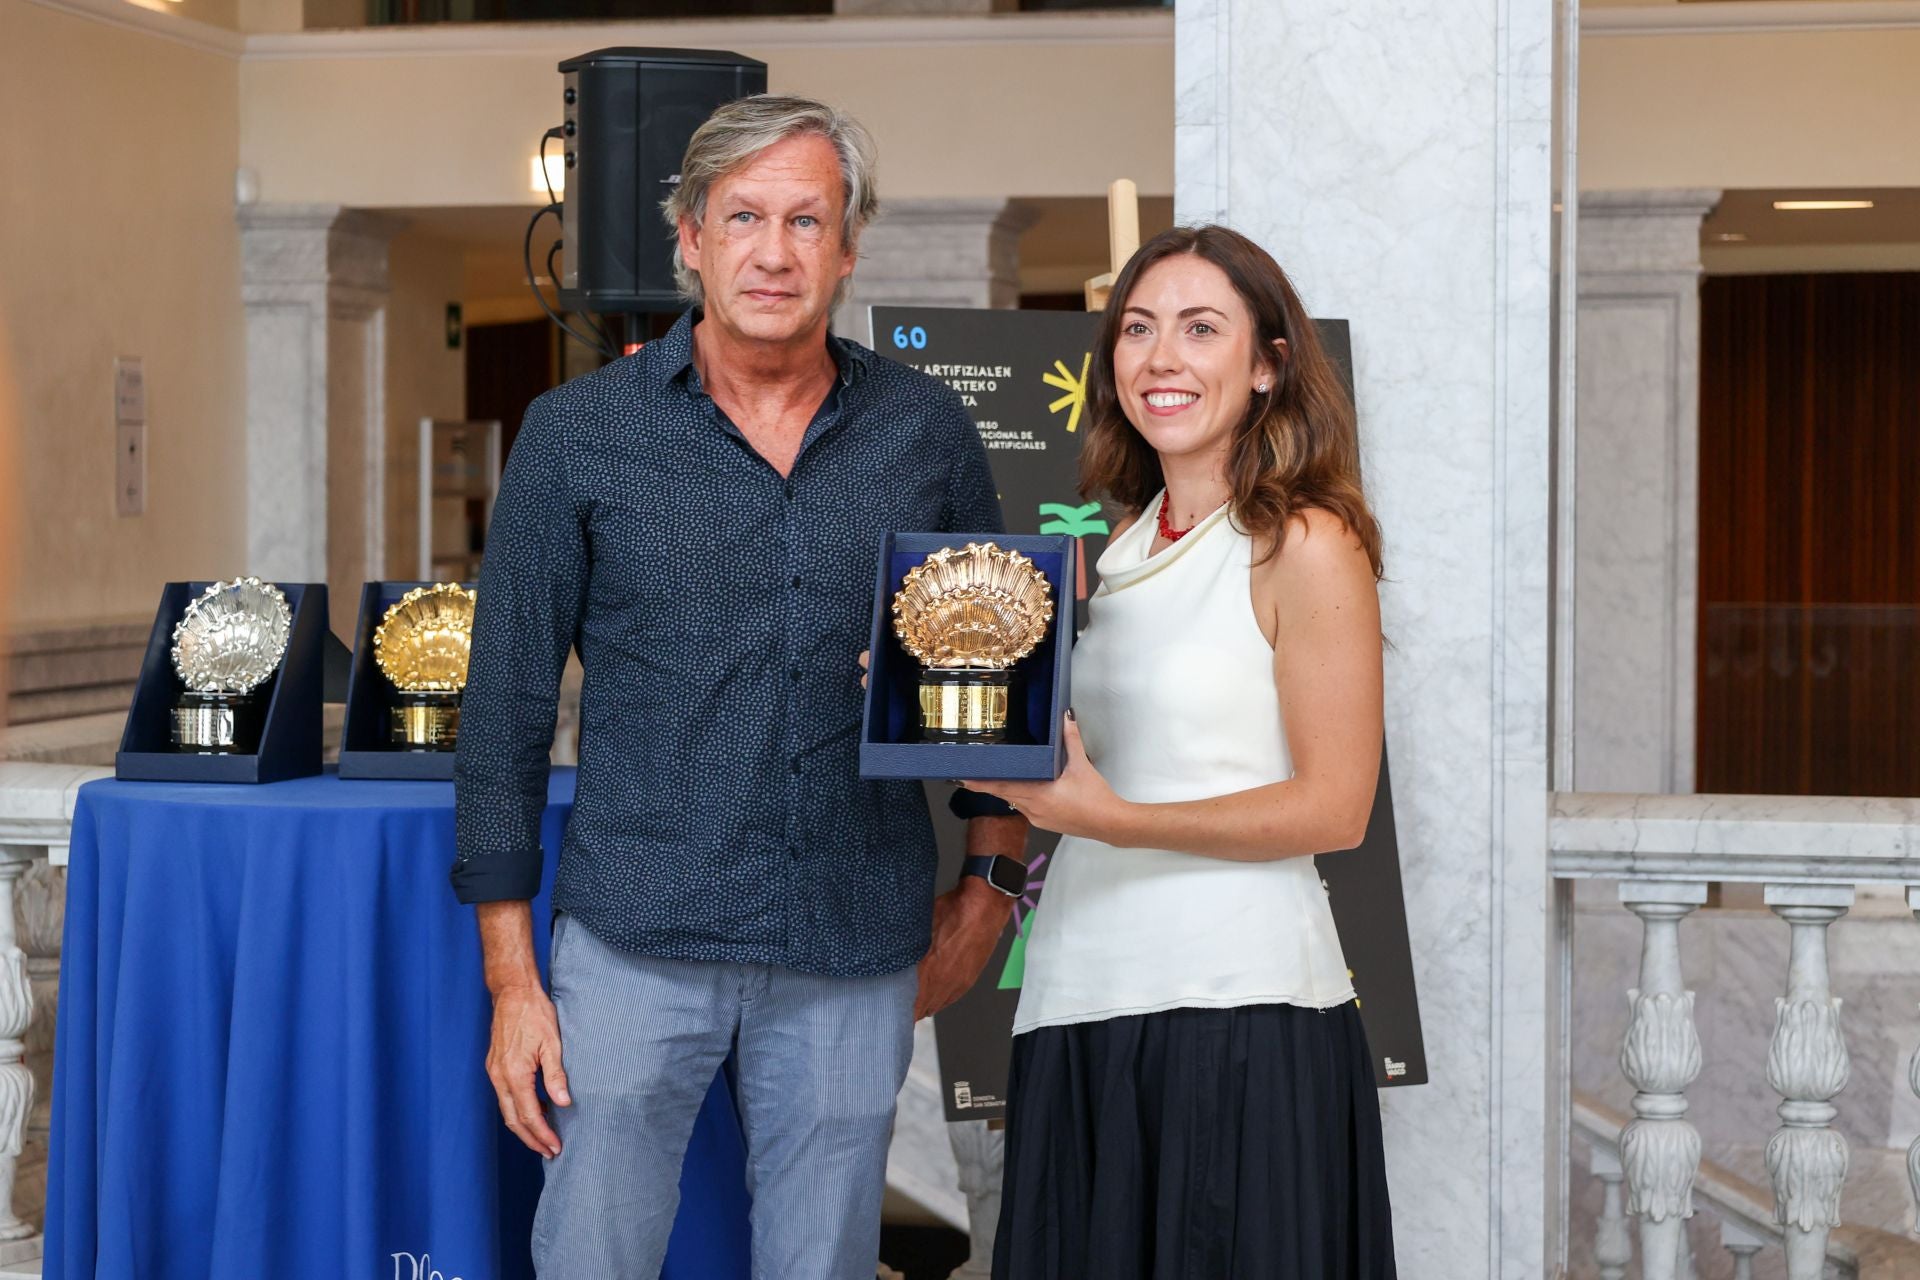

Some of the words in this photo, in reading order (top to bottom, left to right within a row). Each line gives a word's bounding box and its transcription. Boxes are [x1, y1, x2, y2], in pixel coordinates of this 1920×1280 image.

[893, 325, 927, 349] 60
[923, 364, 1012, 378] ARTIFIZIALEN
[1020, 431, 1033, 440] DE
[987, 441, 1047, 450] ARTIFICIALES
